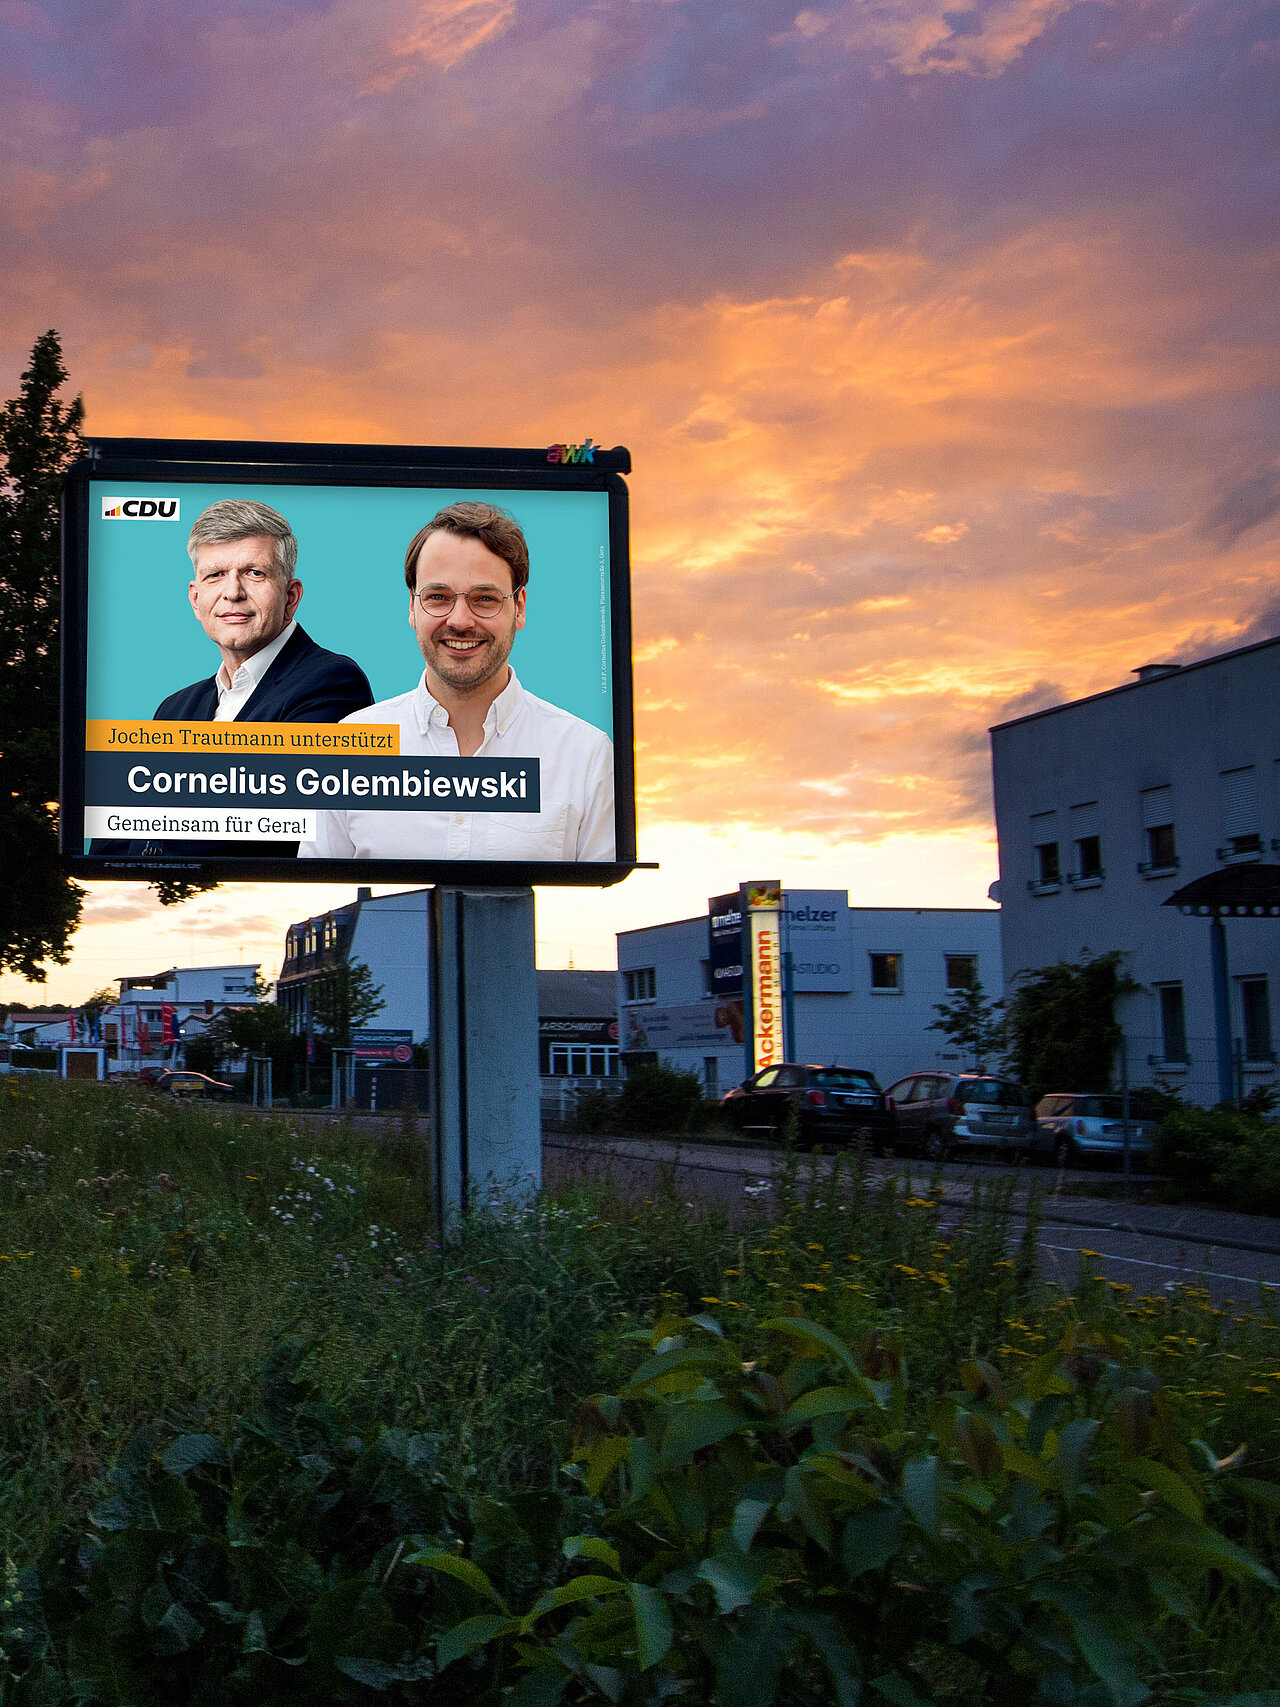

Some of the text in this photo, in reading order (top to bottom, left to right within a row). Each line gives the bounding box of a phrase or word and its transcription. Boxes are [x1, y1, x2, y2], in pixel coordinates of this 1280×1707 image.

[122, 500, 177, 518] CDU
[107, 727, 394, 749] Jochen Trautmann unterstützt
[127, 765, 527, 798] Cornelius Golembiewski
[107, 814, 307, 834] Gemeinsam für Gera!
[757, 930, 775, 1068] Ackermann
[540, 1022, 606, 1031] ARSCHMIDT
